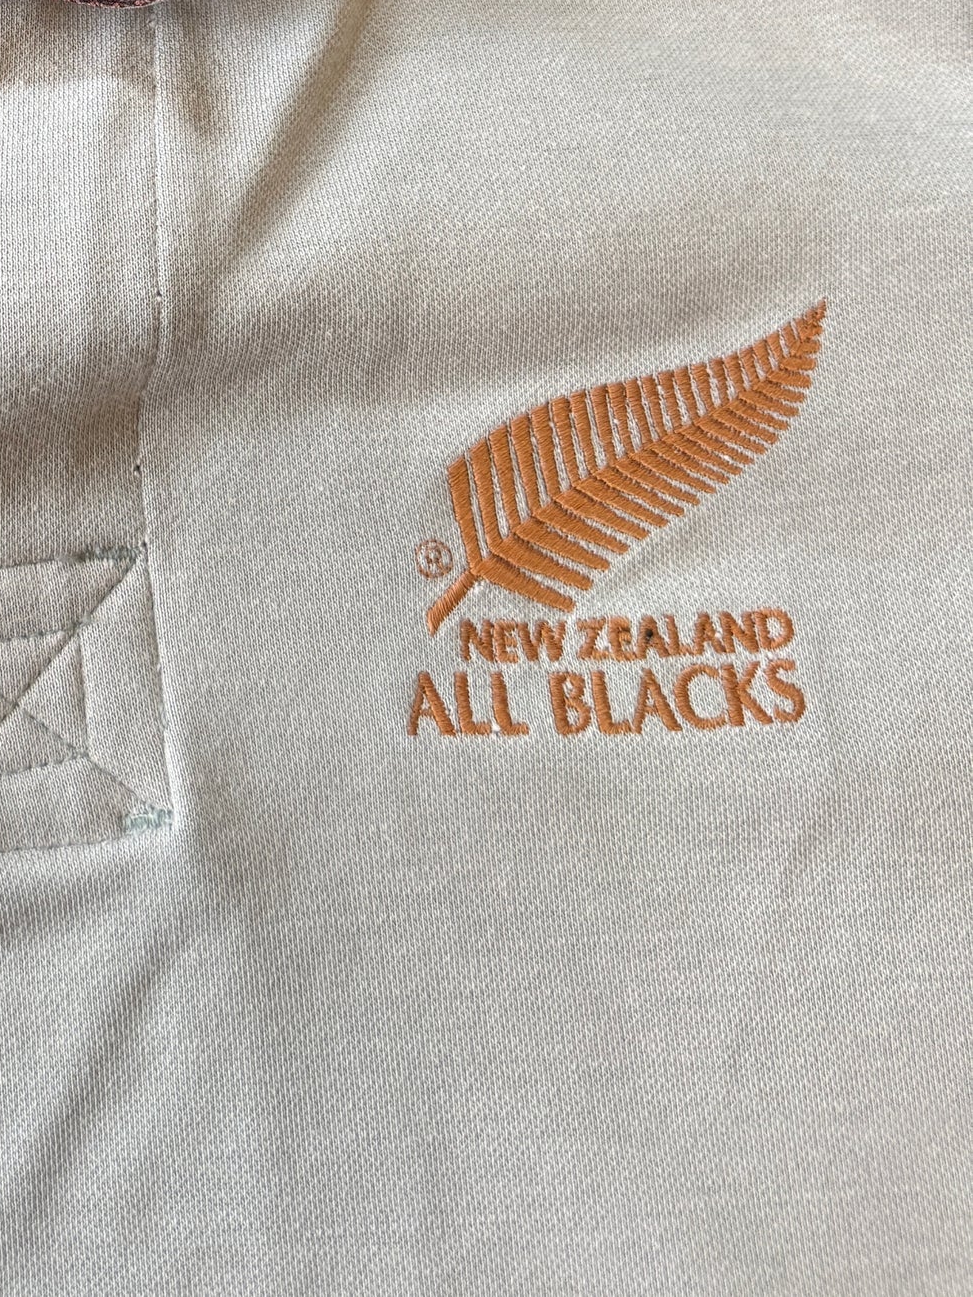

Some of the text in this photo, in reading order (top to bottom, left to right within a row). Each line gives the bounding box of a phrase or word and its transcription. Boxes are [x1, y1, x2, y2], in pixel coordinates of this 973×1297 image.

[459, 608, 795, 663] NEW ZEALAND
[406, 659, 807, 737] ALL BLACKS
